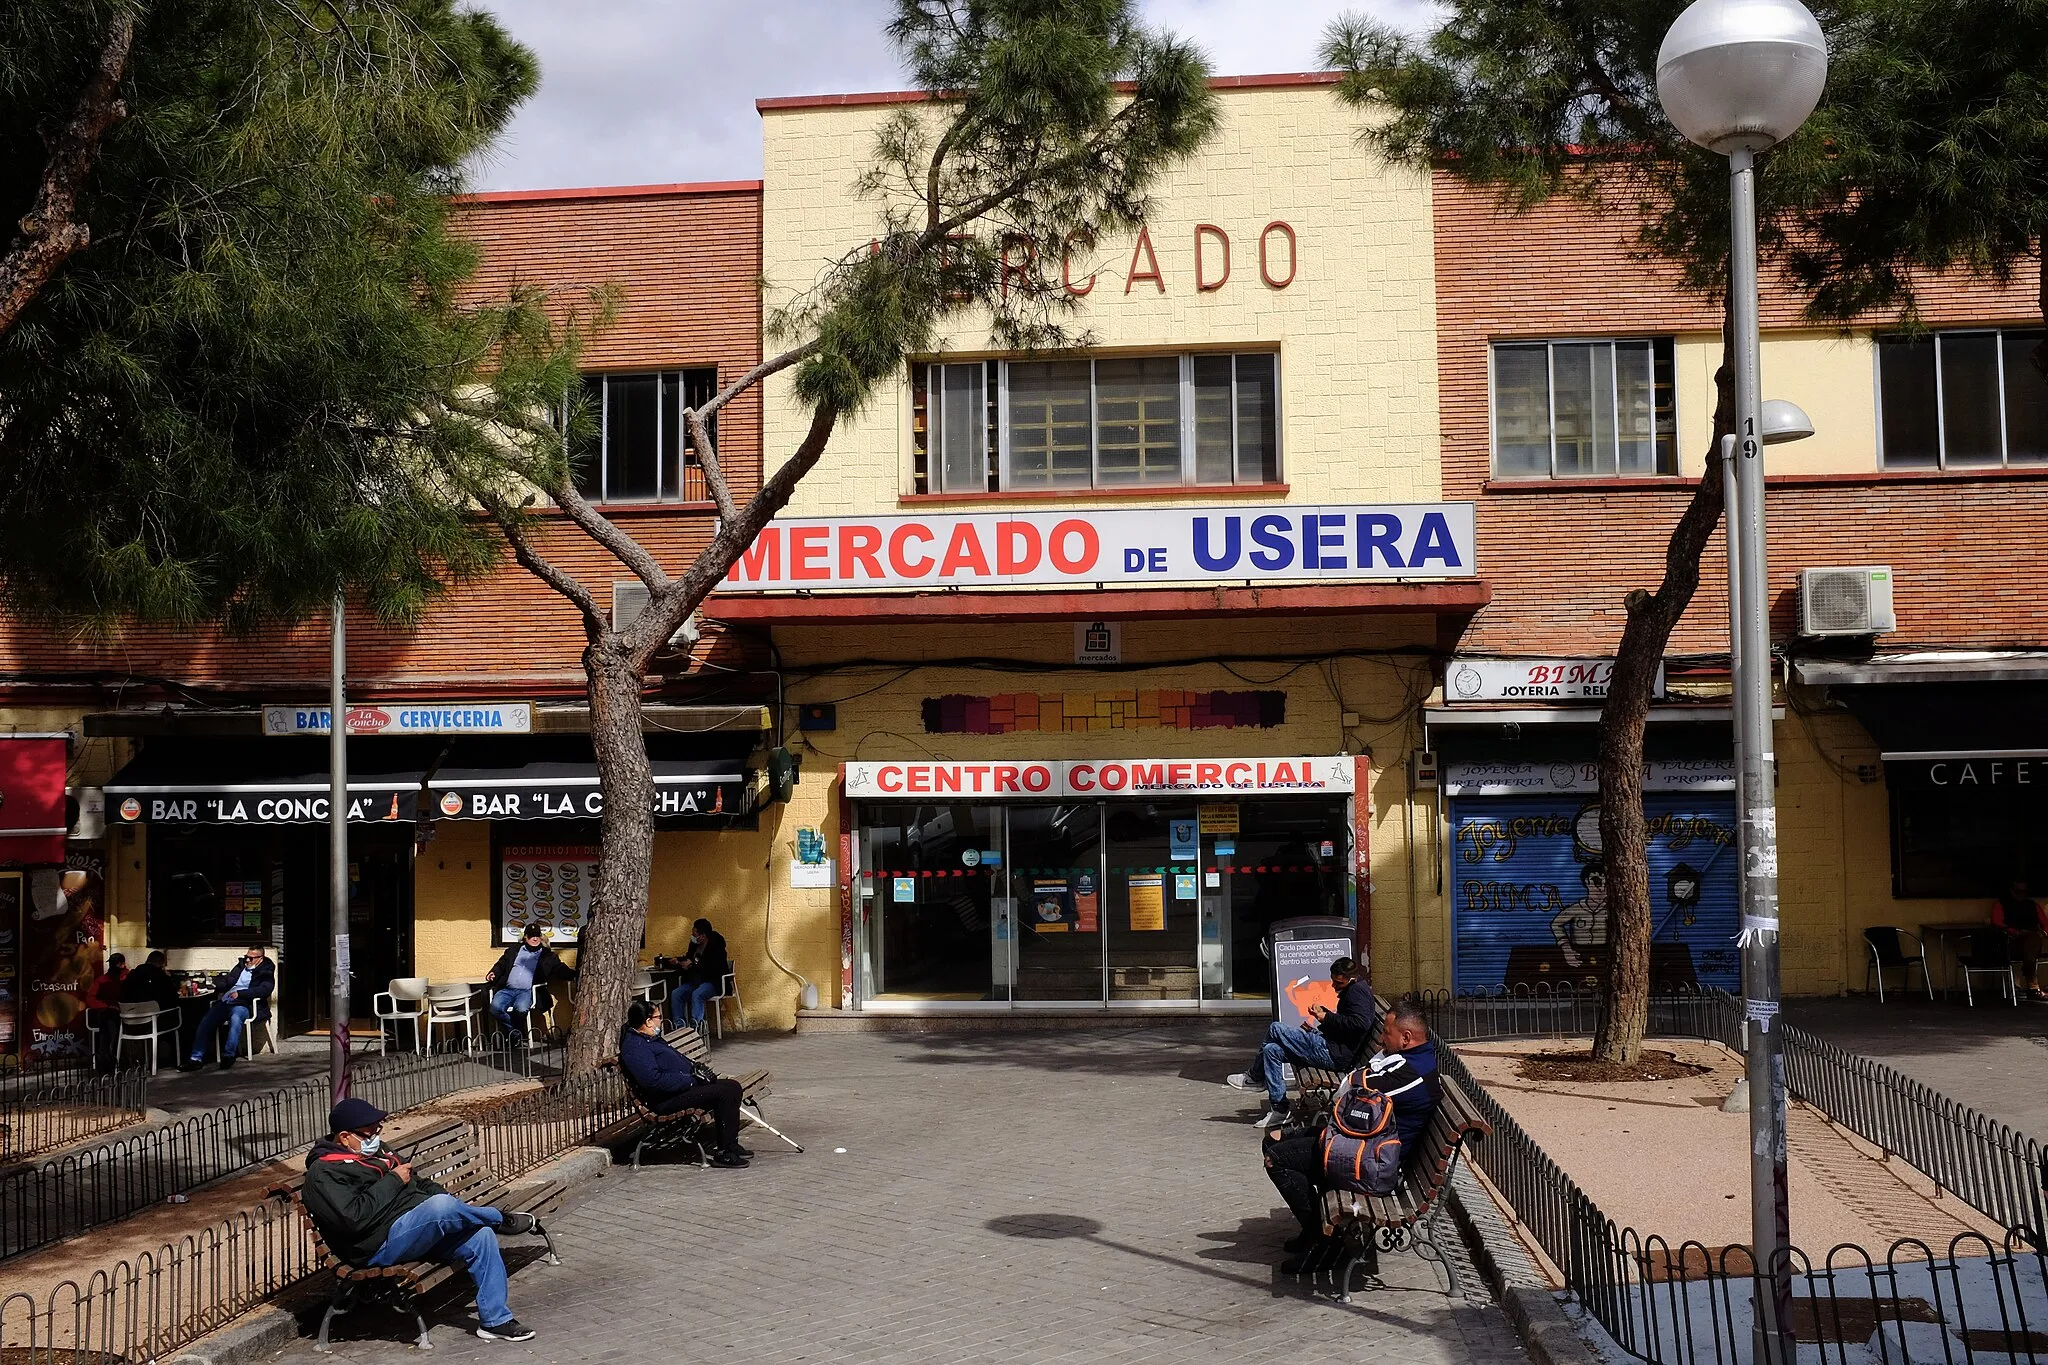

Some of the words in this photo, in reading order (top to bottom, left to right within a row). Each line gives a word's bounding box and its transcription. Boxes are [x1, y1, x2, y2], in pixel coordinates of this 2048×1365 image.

[725, 518, 1100, 583] MERCADO
[1123, 547, 1168, 573] DE
[1192, 512, 1463, 573] USERA
[1501, 686, 1560, 697] JOYERIA
[296, 711, 331, 729] BAR
[360, 710, 372, 720] La
[399, 710, 503, 728] CERVECERIA
[347, 718, 385, 728] Concha
[1461, 765, 1534, 777] JOYERIA
[1658, 760, 1736, 771] TALLERE
[877, 765, 1051, 792] CENTRO
[1068, 762, 1326, 792] COMERCIAL
[1663, 774, 1737, 785] PROPIO
[1930, 762, 2048, 785] CAFE
[1451, 777, 1545, 789] RELOJERIA
[152, 800, 197, 820] BAR
[257, 799, 373, 820] CONCA”
[472, 794, 520, 815] BAR
[1457, 814, 1571, 861] Joyeria
[1463, 880, 1564, 911] BIMA
[76, 931, 95, 944] Pan
[1296, 943, 1323, 951] papelera
[1317, 949, 1345, 957] Deposita
[32, 1029, 75, 1047] Enrollado
